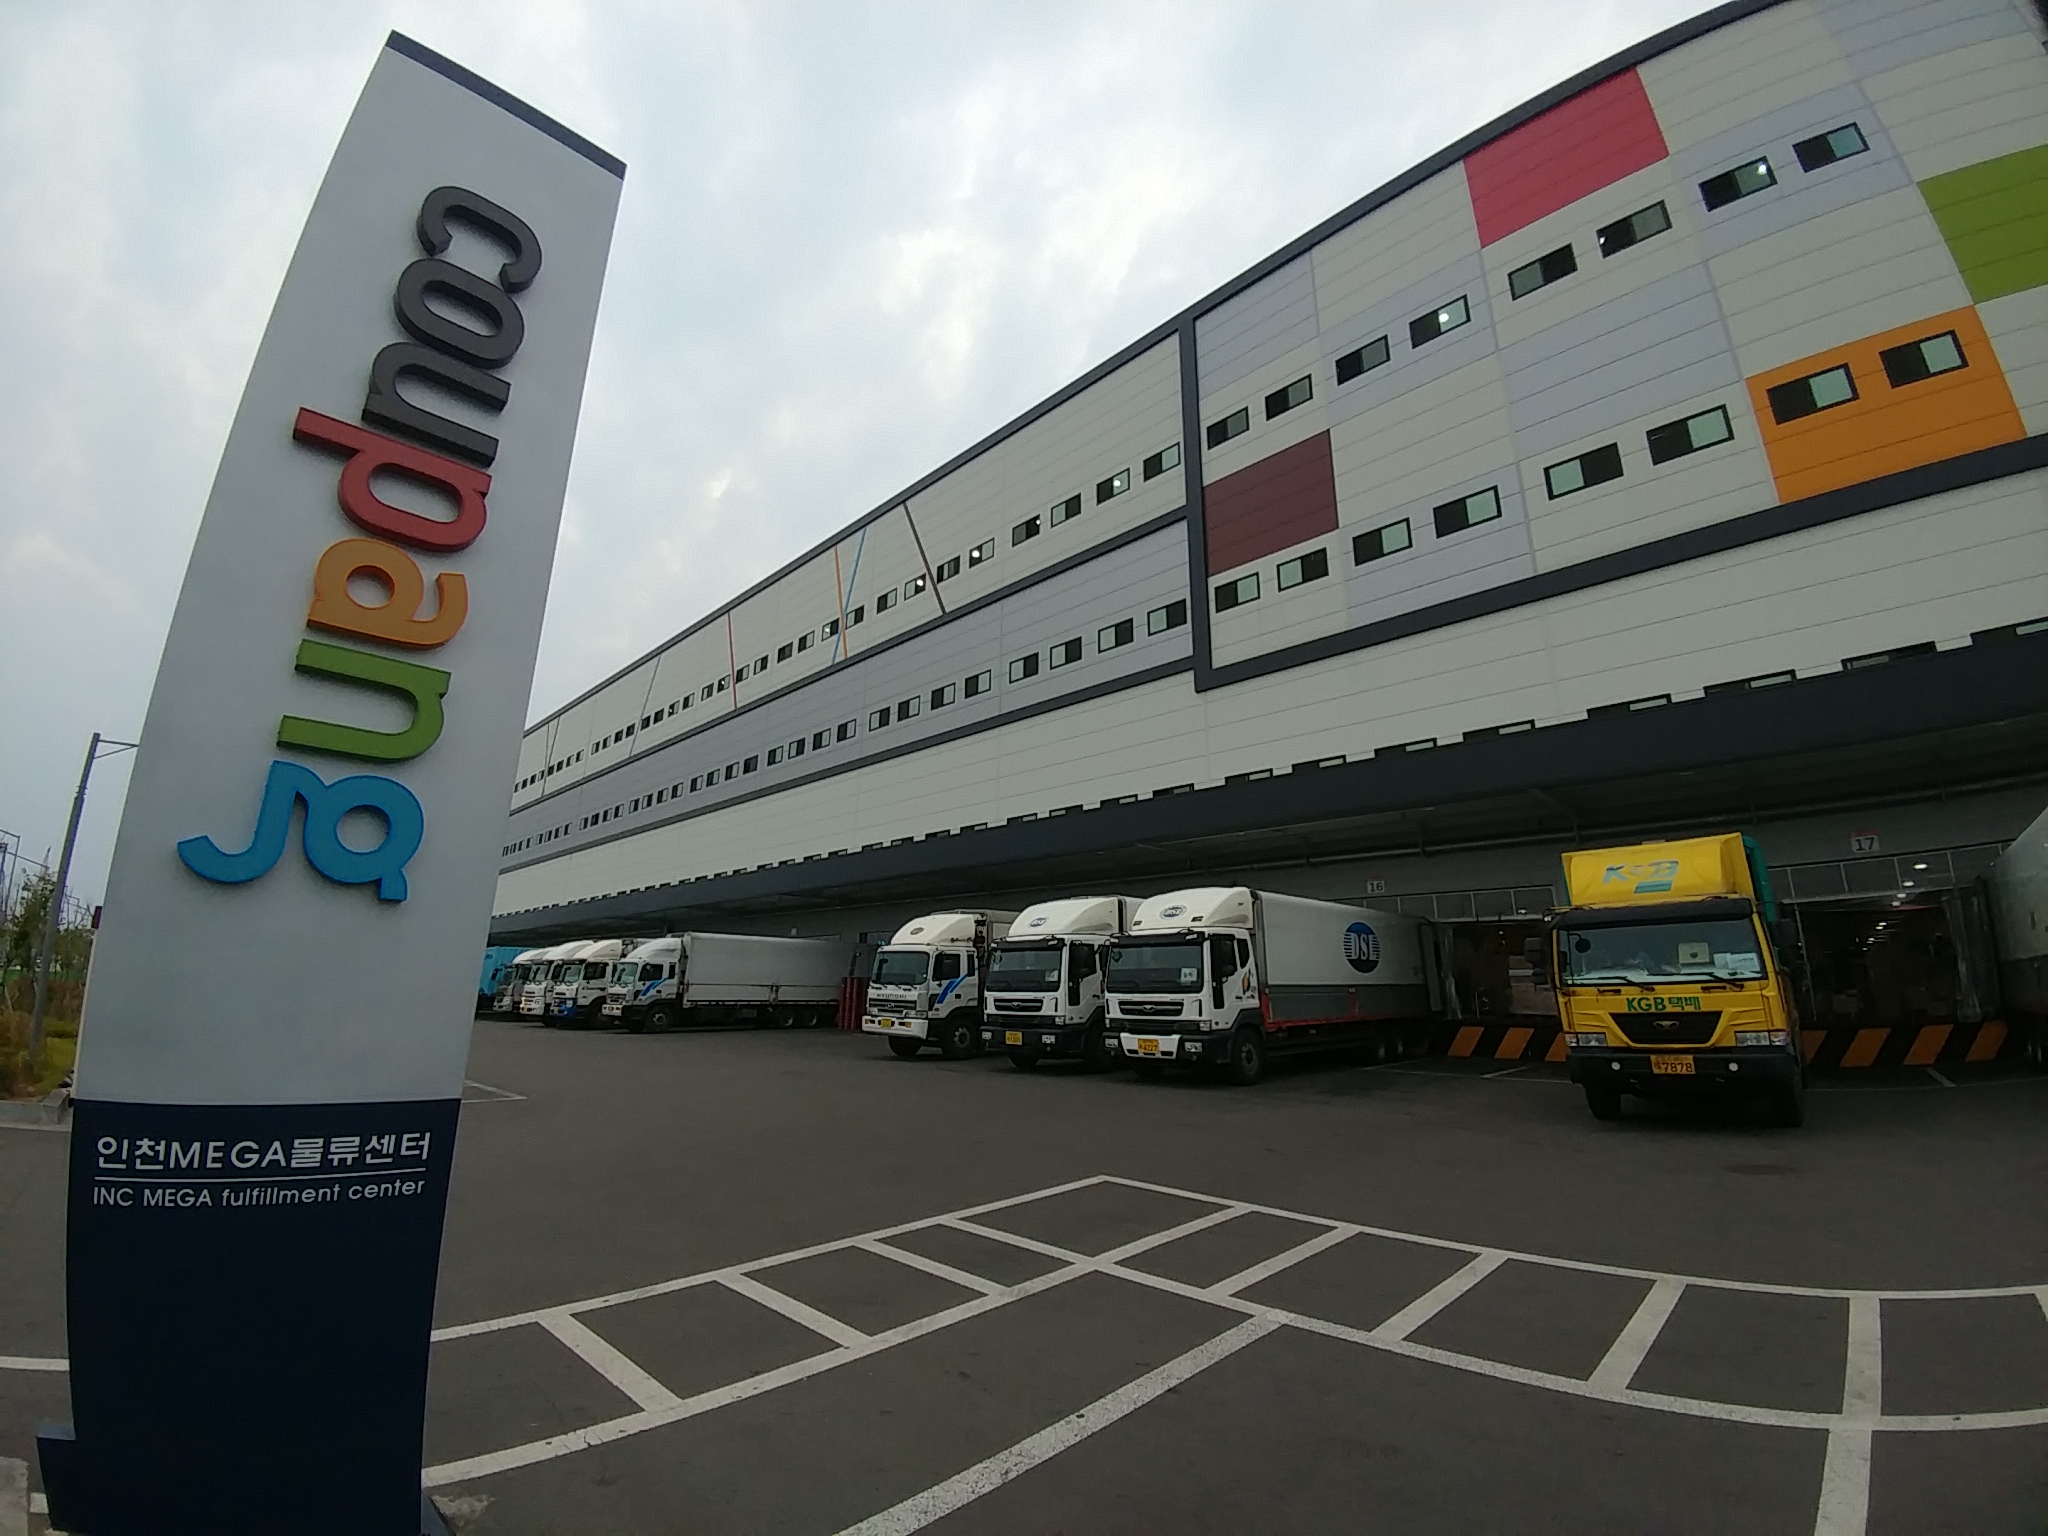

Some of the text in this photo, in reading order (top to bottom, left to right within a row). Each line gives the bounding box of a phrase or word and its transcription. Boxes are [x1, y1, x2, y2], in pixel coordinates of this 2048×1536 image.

[177, 185, 541, 902] coupang
[1854, 837, 1875, 851] 17
[1369, 881, 1384, 893] 16
[1626, 996, 1666, 1011] KGB
[97, 1132, 430, 1170] 인천MEGA물류센터
[93, 1178, 425, 1207] INC MEGA fulfillment center
